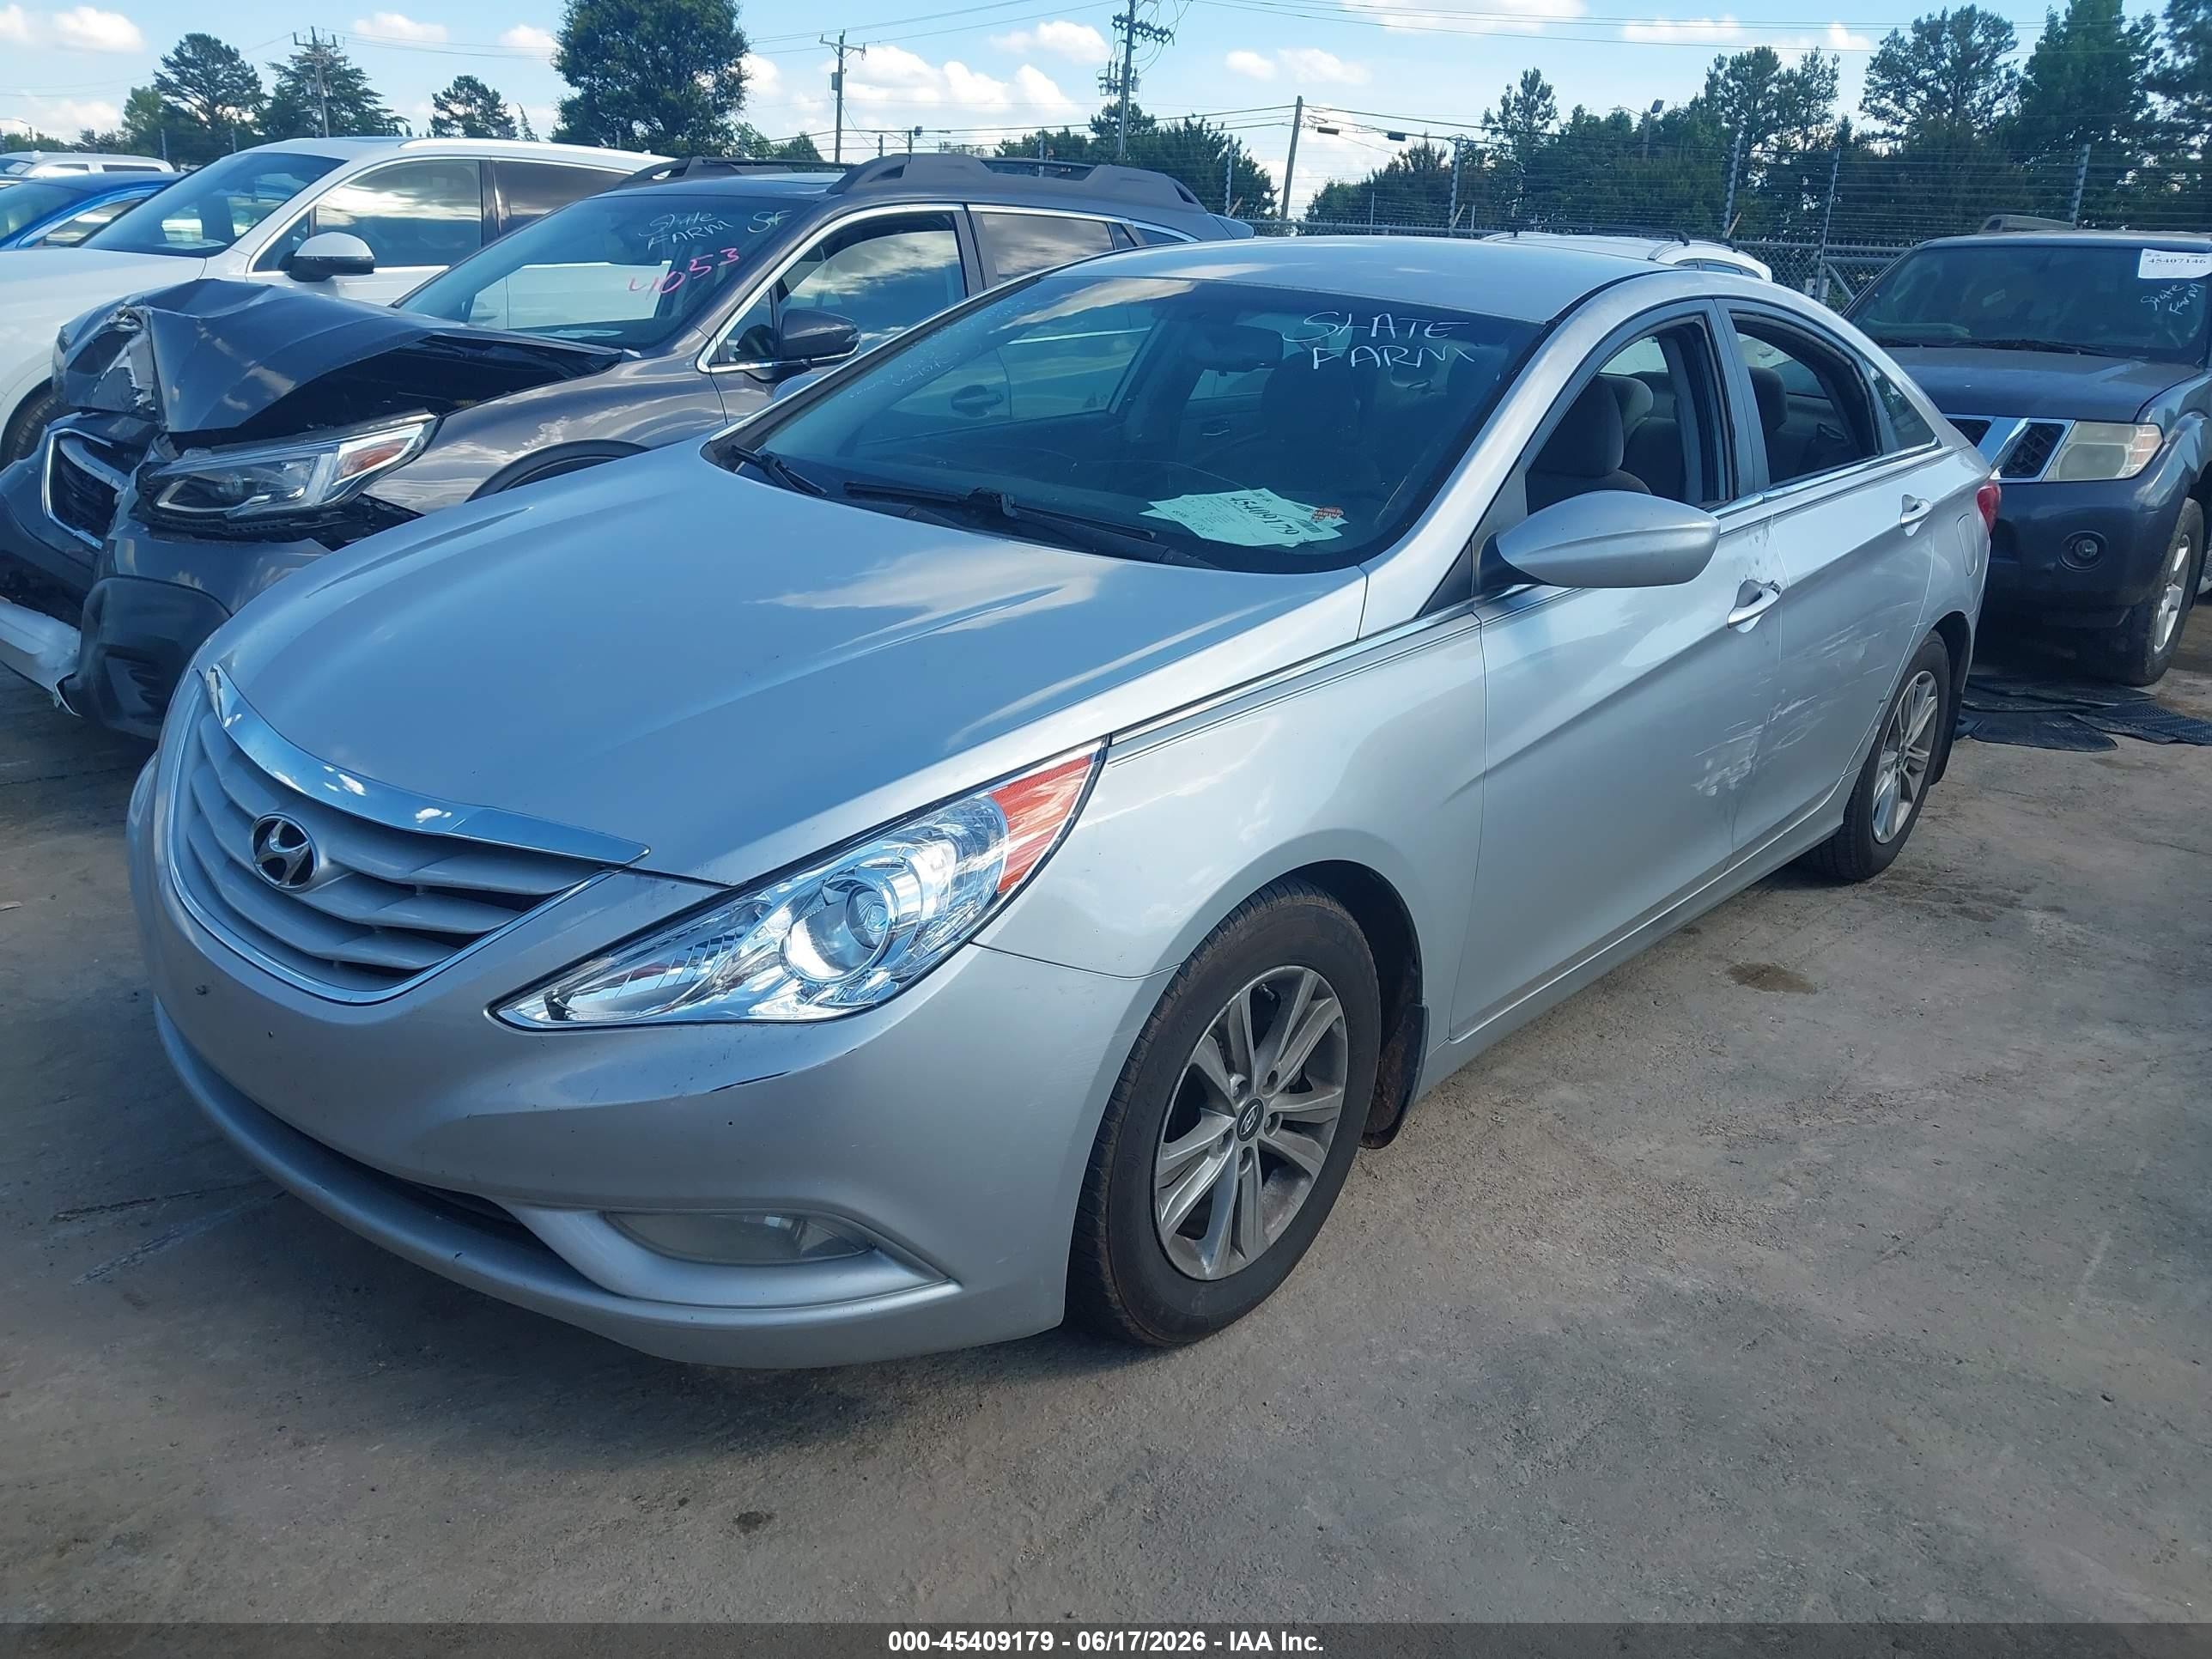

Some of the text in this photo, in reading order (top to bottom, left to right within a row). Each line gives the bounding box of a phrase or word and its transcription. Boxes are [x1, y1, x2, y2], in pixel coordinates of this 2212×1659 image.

[647, 220, 733, 251] FARM
[746, 210, 793, 234] SF
[1313, 345, 1475, 370] FARM
[1229, 496, 1301, 537] 45409179
